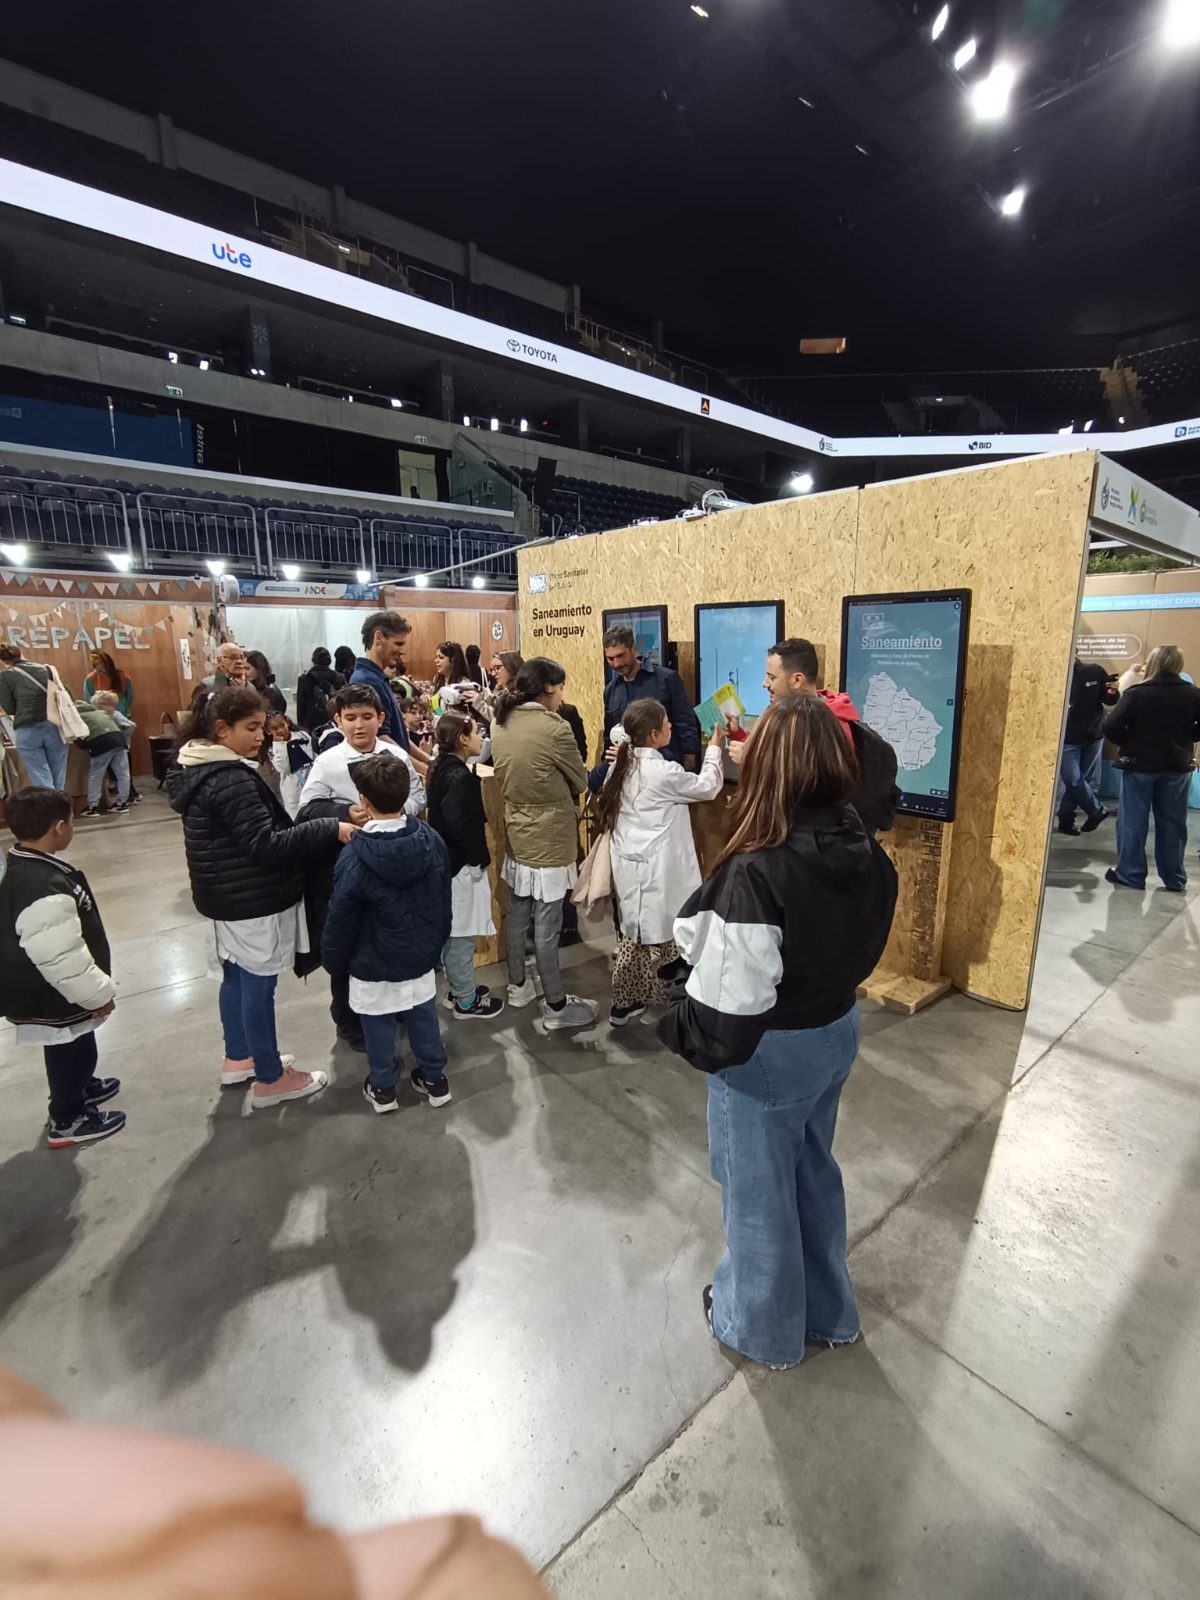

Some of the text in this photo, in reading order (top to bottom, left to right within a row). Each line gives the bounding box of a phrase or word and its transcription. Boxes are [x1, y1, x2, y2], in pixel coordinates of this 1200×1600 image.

[212, 243, 252, 268] ute
[522, 344, 558, 363] TOYOTA
[533, 604, 592, 620] Saneamiento
[533, 624, 585, 639] en Uruguay
[861, 635, 943, 649] Saneamiento
